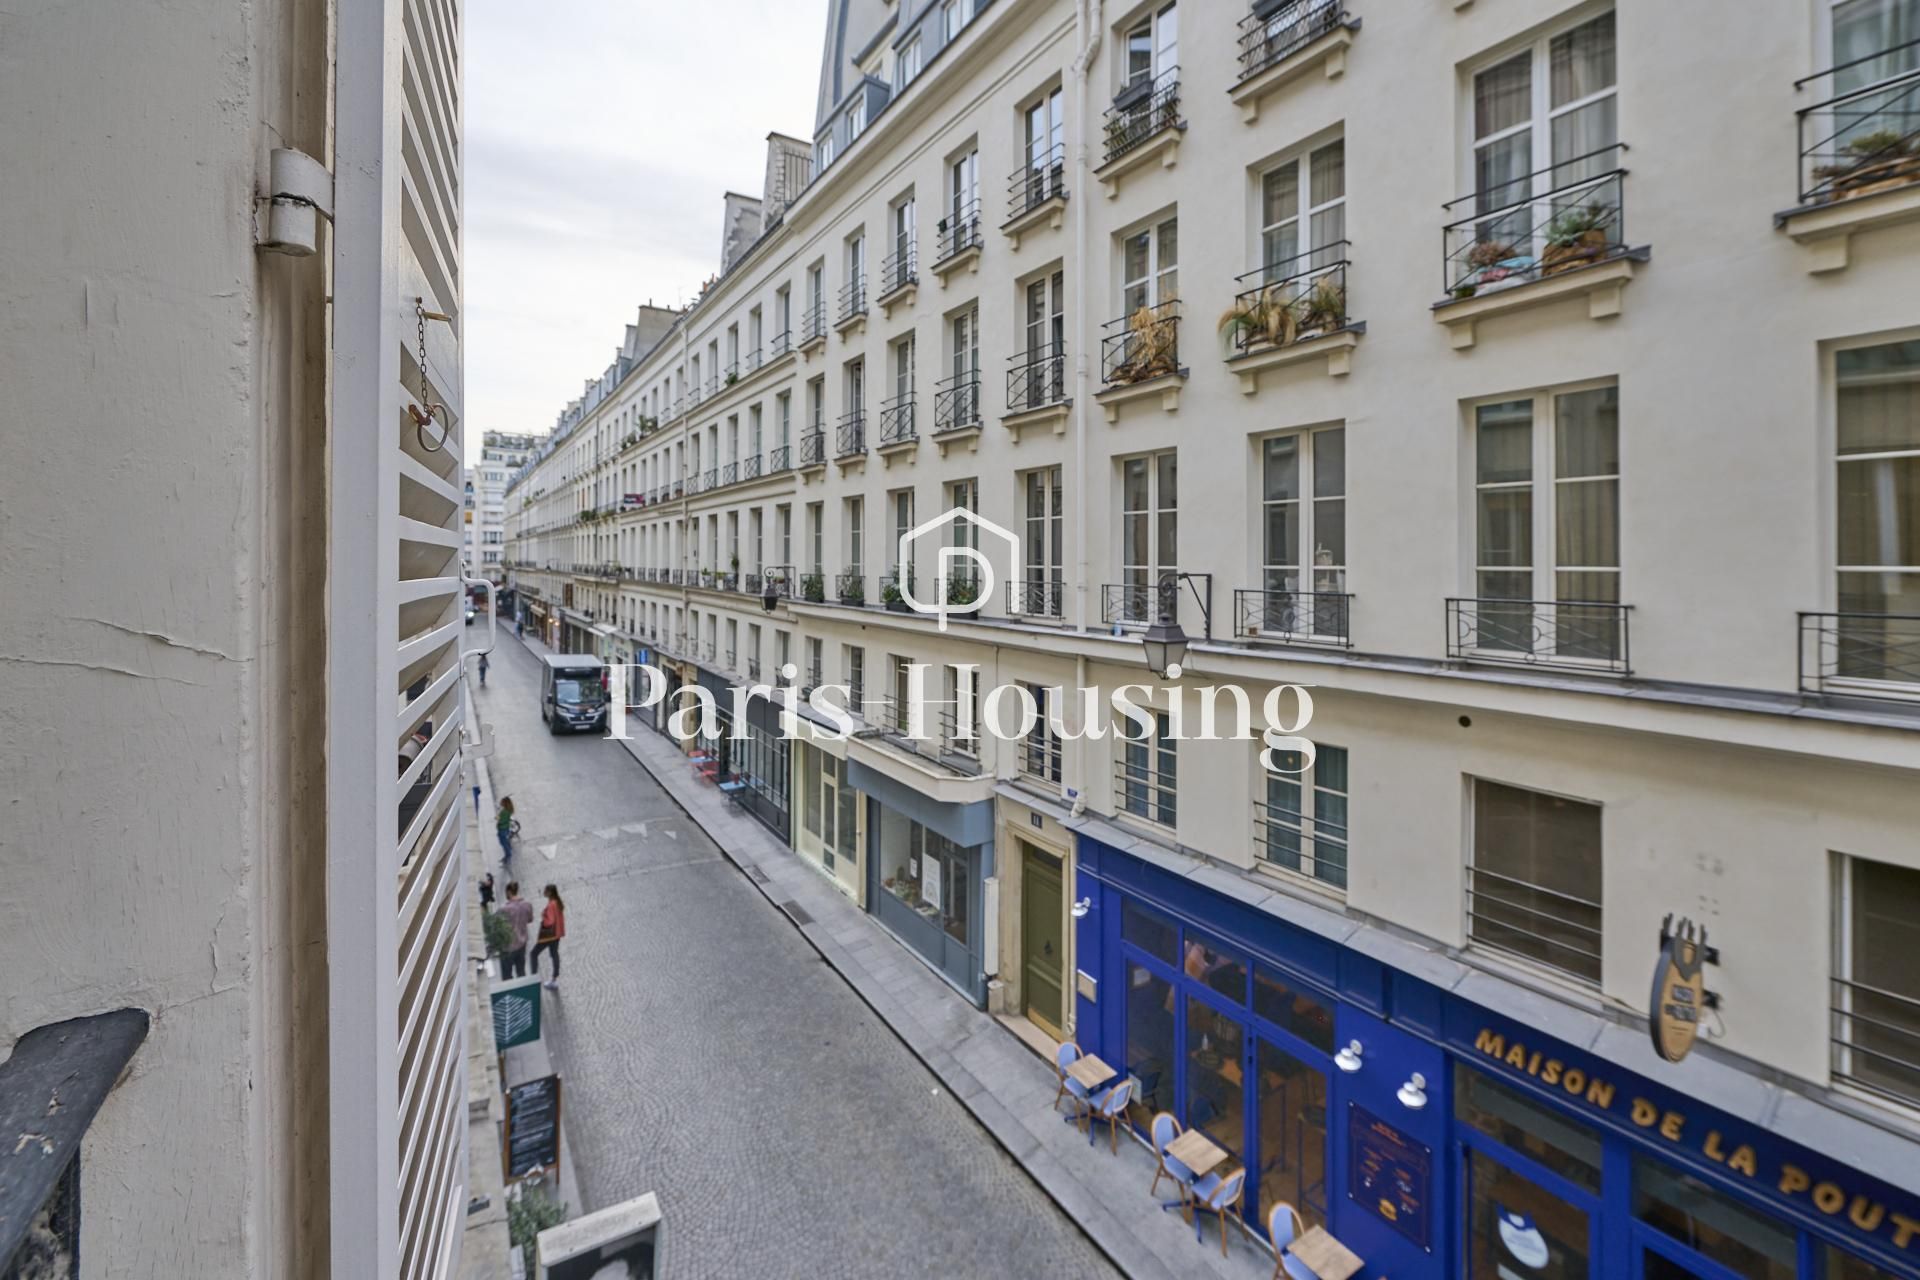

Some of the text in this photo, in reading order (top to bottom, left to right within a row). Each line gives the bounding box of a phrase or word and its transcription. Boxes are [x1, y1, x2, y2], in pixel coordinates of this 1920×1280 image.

[1475, 1028, 1920, 1248] MAISON DE LA POUT
